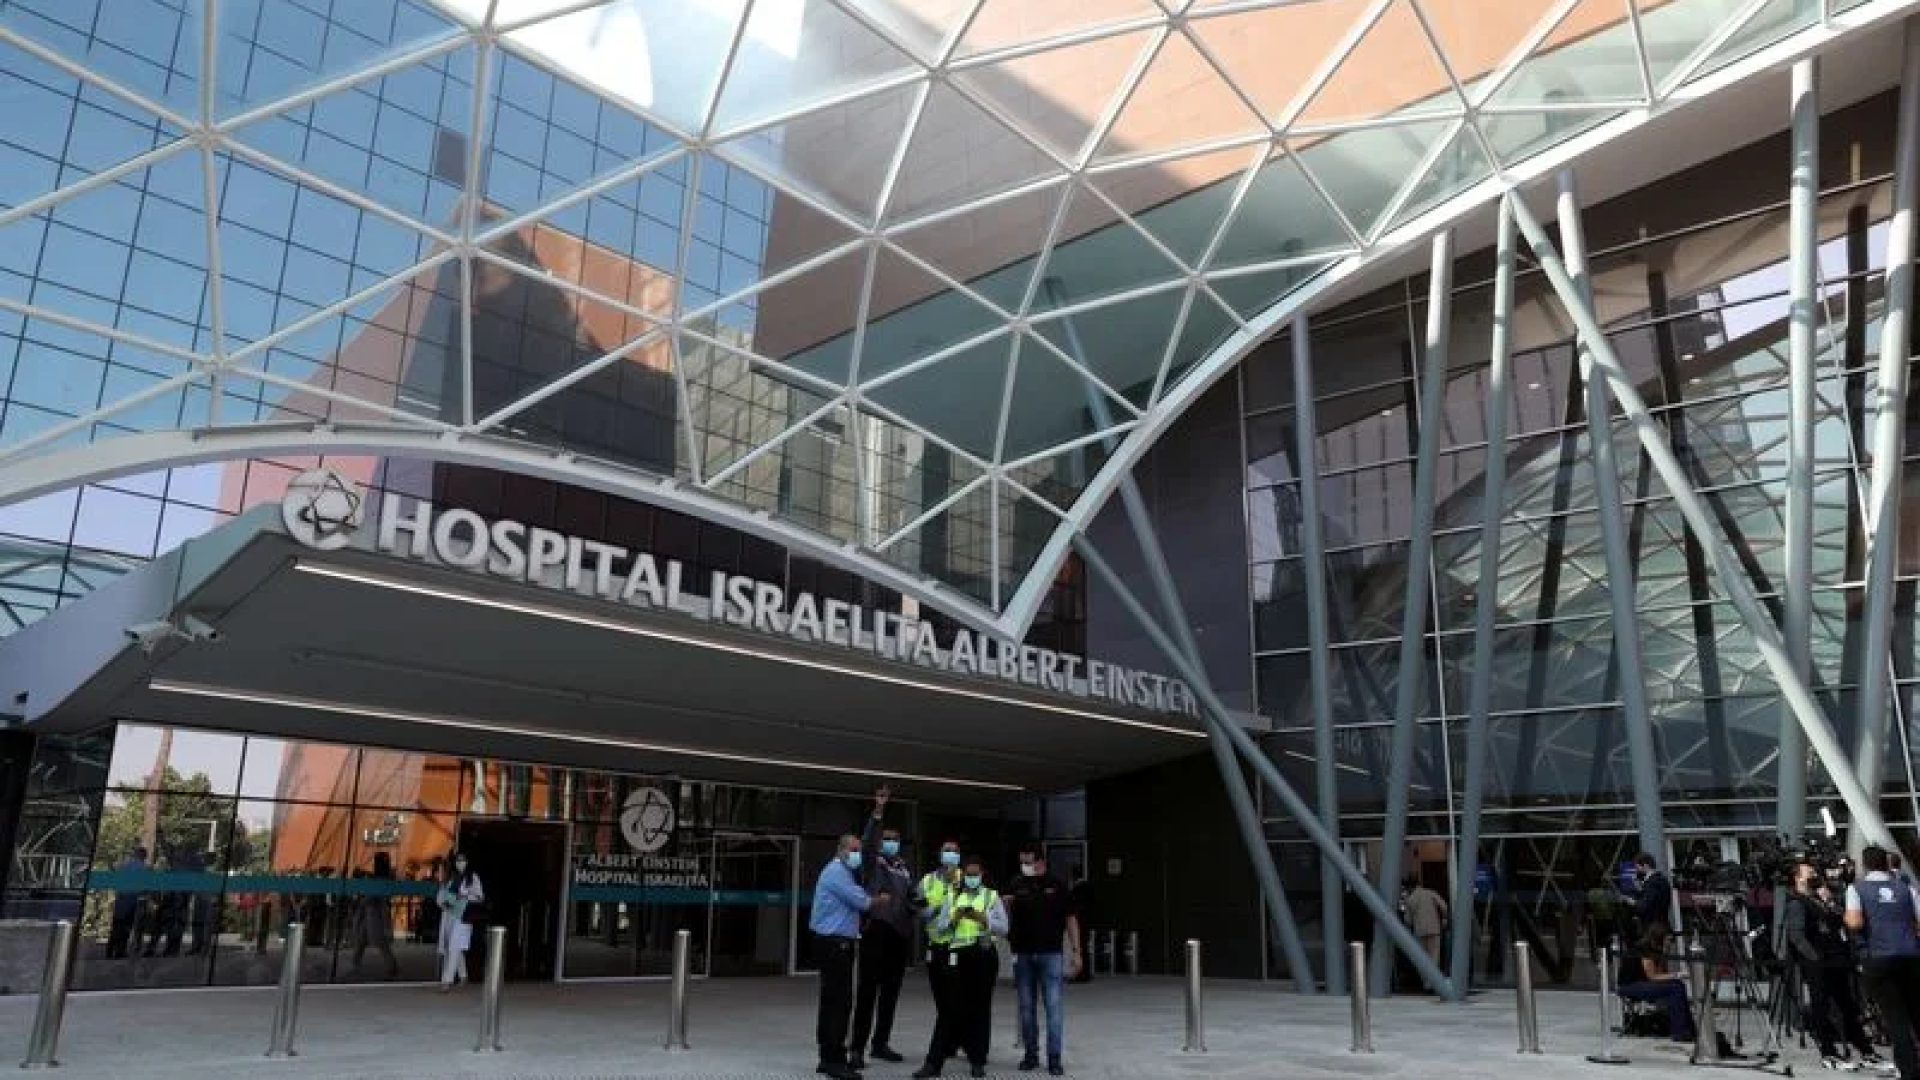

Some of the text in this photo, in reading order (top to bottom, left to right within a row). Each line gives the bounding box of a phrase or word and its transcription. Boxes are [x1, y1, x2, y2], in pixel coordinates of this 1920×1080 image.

[377, 494, 709, 621] HOSPITAL
[711, 569, 941, 663] ISRAELITA
[951, 629, 1085, 694] ALBERT
[575, 868, 639, 884] HOSPITAL
